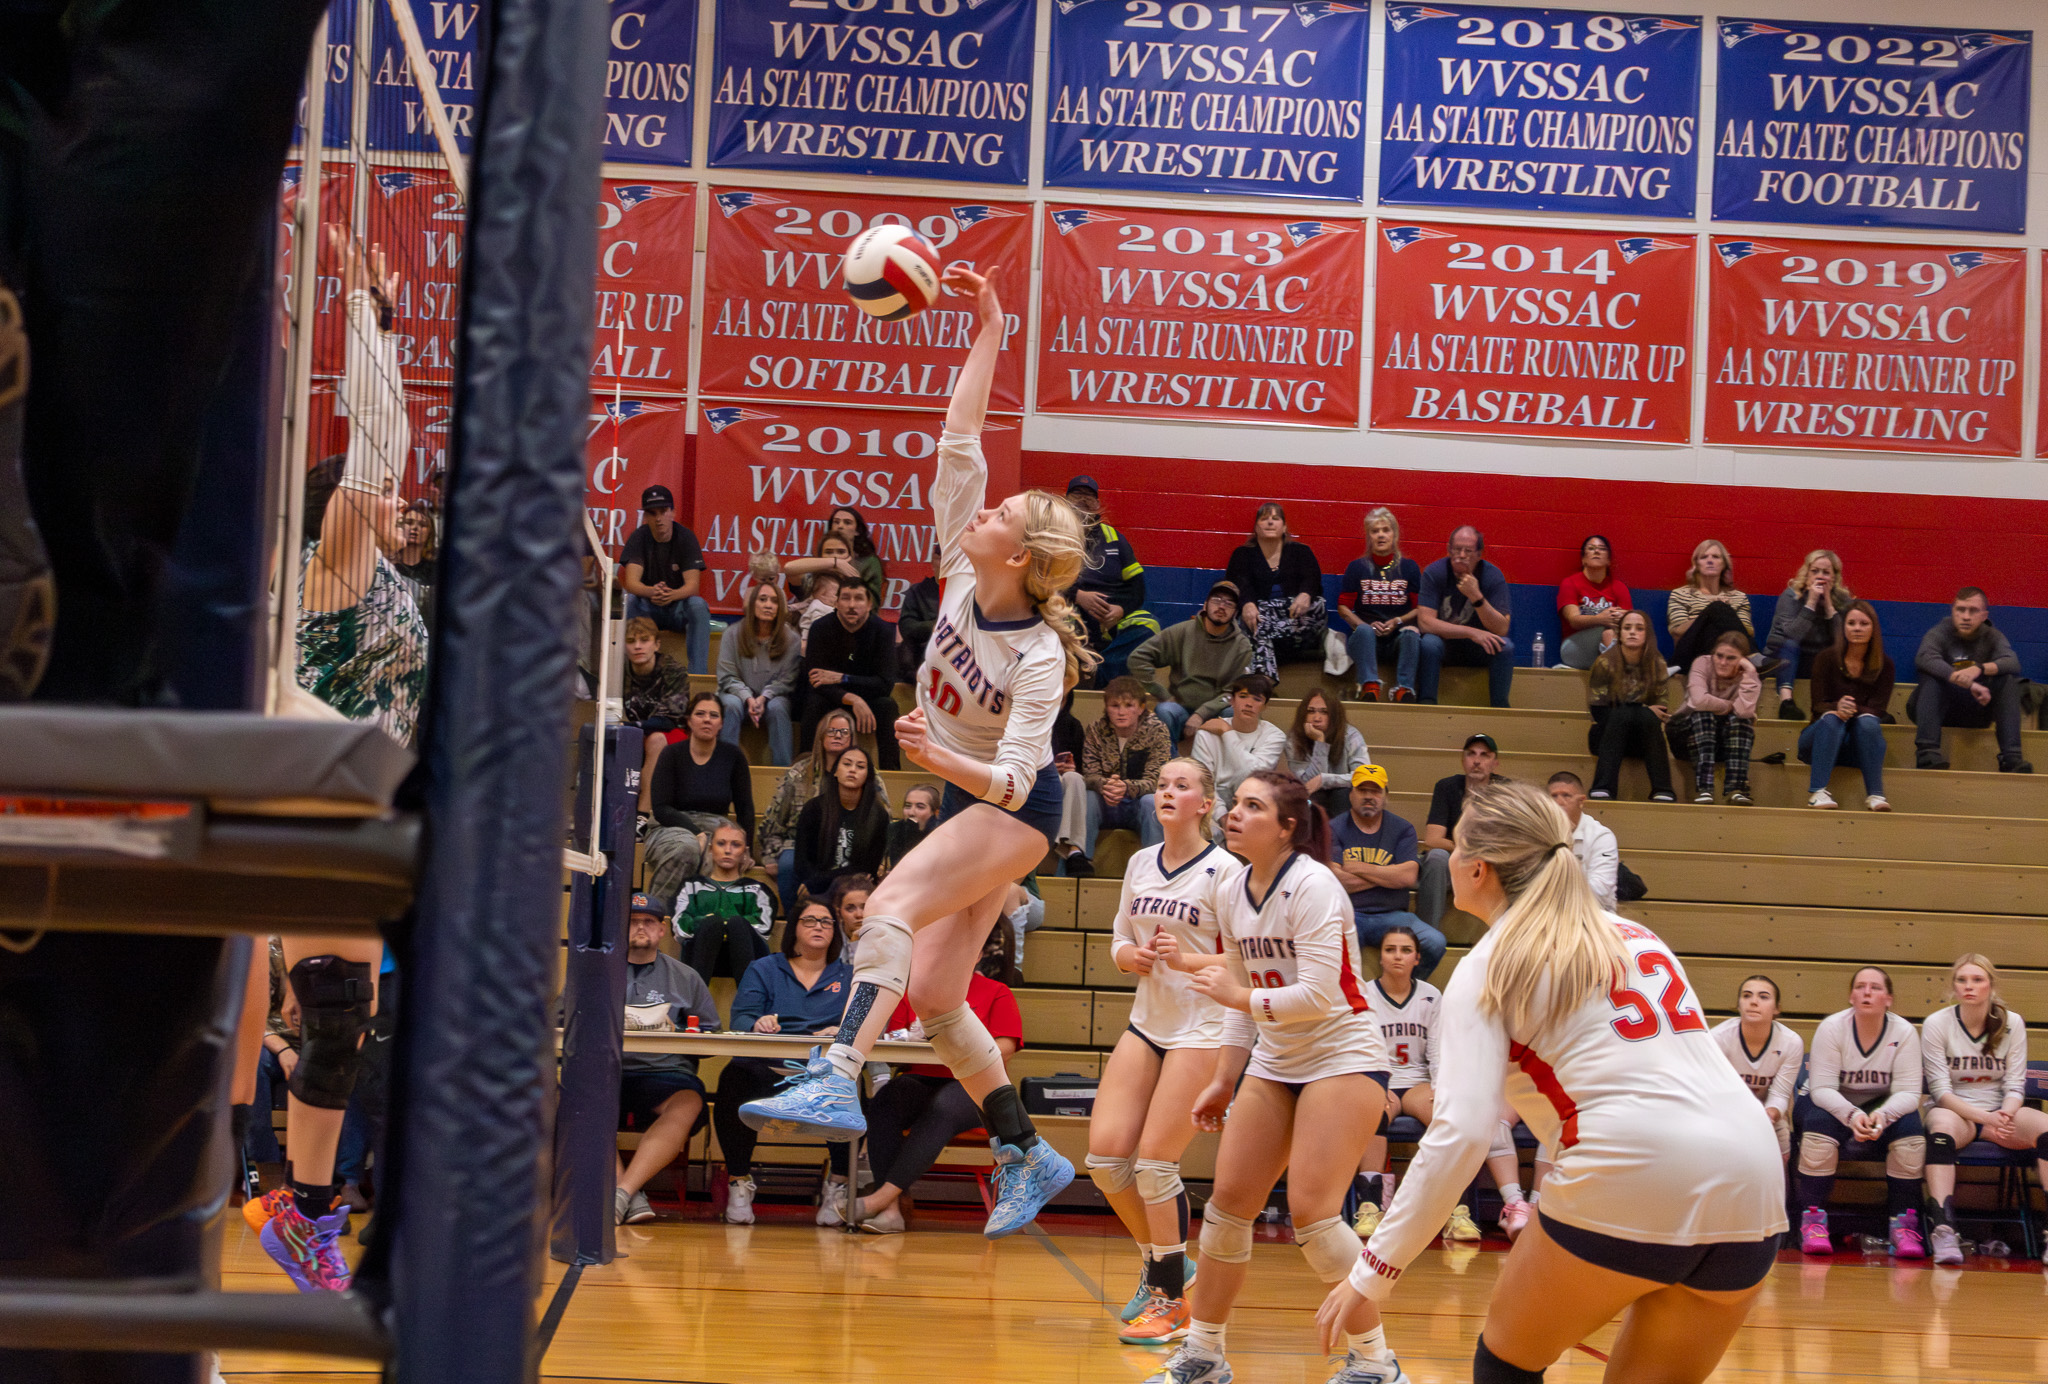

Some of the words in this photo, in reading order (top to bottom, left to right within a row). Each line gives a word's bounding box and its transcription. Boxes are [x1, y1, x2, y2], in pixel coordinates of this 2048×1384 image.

[1124, 1, 1290, 42] 2017
[1457, 16, 1627, 52] 2018
[770, 21, 983, 69] WVSSAC
[1105, 40, 1318, 88] WVSSAC
[1783, 33, 1959, 67] 2022
[603, 60, 691, 103] PIONS
[714, 66, 754, 106] AA
[760, 68, 851, 111] STATE
[856, 74, 1028, 121] CHAMPIONS
[1438, 57, 1649, 104] WVSSAC
[1769, 73, 1980, 119] WVSSAC
[1051, 85, 1090, 124] AA
[1096, 88, 1186, 130] STATE
[1190, 92, 1363, 139] CHAMPIONS
[1385, 103, 1425, 142] AA
[1429, 104, 1519, 147] STATE
[1523, 109, 1694, 155] CHAMPIONS
[743, 120, 1003, 166] WRESTLING
[1080, 139, 1338, 184] WRESTLING
[1717, 119, 1756, 158] AA
[1761, 121, 1850, 162] STATE
[1855, 125, 2023, 170] CHAMPIONS
[1413, 156, 1671, 200] WRESTLING
[1753, 170, 1980, 212] FOOTBALL
[1118, 224, 1284, 267] 2013
[1447, 242, 1616, 285] 2014
[1097, 266, 1309, 313] WVSSAC
[1781, 256, 1947, 298] 2019
[712, 299, 750, 337] AA
[758, 300, 849, 342] STATE
[1429, 283, 1641, 330] WVSSAC
[1762, 299, 1971, 344] WVSSAC
[1049, 315, 1089, 354] AA
[1095, 316, 1184, 359] STATE
[1188, 322, 1308, 365] RUNNER
[1315, 328, 1354, 367] UP
[1382, 332, 1422, 370] AA
[1428, 333, 1517, 375] STATE
[1521, 338, 1640, 382] RUNNER
[1647, 345, 1686, 383] UP
[1068, 368, 1326, 413] WRESTLING
[1716, 347, 1755, 386] AA
[1760, 348, 1849, 389] STATE
[1852, 353, 1970, 395] RUNNER
[1978, 359, 2016, 396] UP
[1406, 387, 1656, 430] BASEBALL
[1734, 400, 1989, 443] WRESTLING
[762, 424, 936, 459] 2010
[749, 465, 934, 510] WVSSA
[702, 515, 742, 553] AA
[1130, 897, 1200, 927] ATRIOTS
[1238, 936, 1296, 960] TRIOTS
[1396, 1043, 1409, 1066] 5
